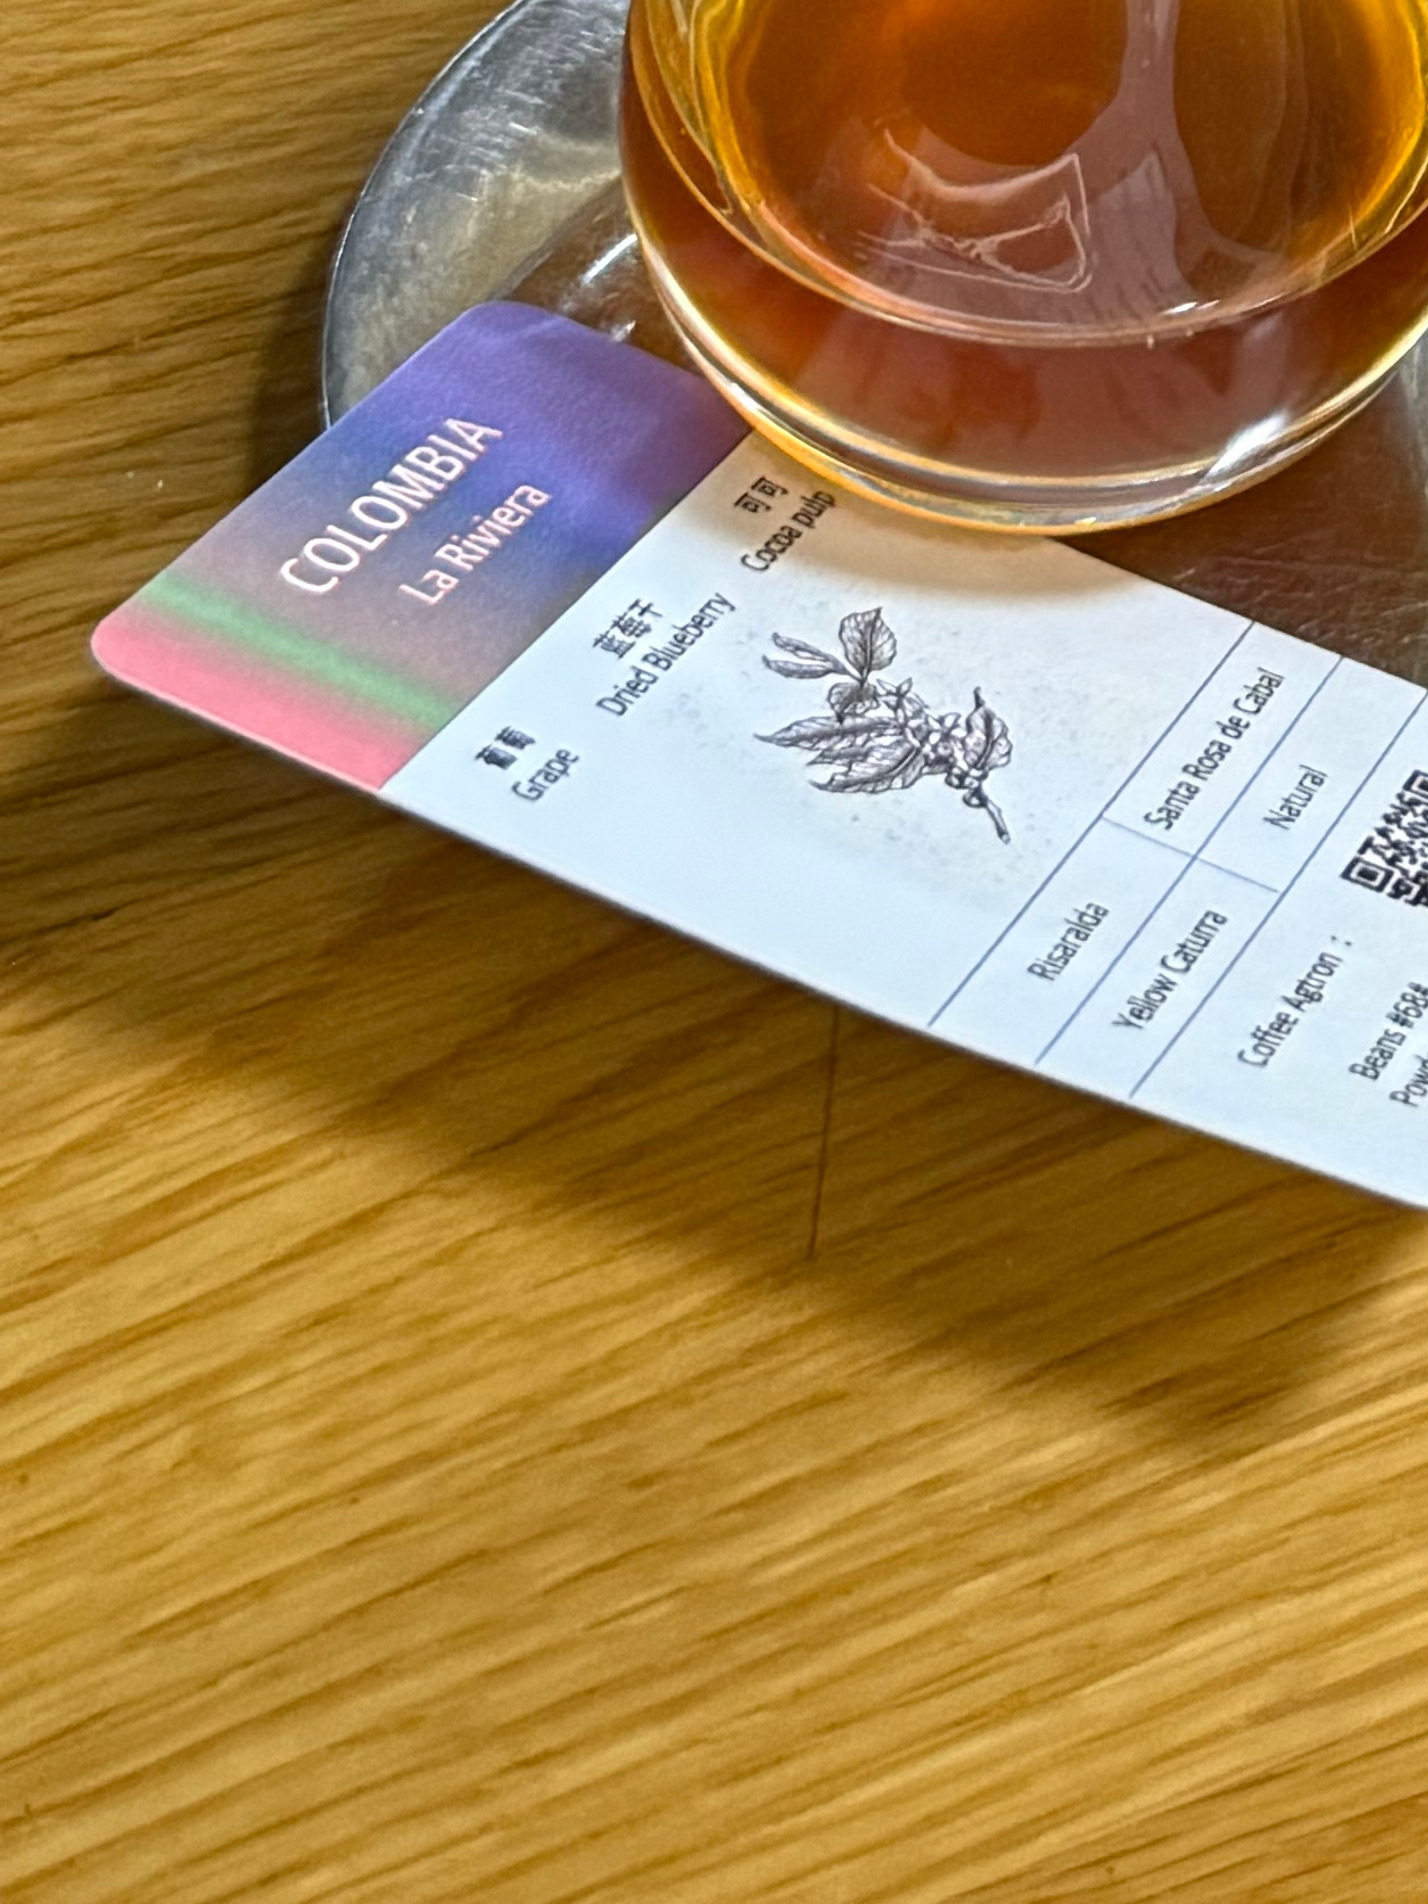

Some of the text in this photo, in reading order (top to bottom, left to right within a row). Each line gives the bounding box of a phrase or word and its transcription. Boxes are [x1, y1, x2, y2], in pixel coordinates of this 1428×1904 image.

[279, 417, 504, 594] COLOMBIA
[732, 475, 789, 514] 可可
[739, 489, 838, 573] Cocoa pulp
[398, 483, 552, 606] La Riviera
[592, 597, 664, 660] 蓝莓干
[595, 591, 737, 717] Dried Blueberry
[511, 747, 580, 803] Grape
[1142, 665, 1287, 833] Santa Rosa de Cabal
[1262, 763, 1329, 833] Natural
[1026, 900, 1110, 982] Risaralda
[1110, 907, 1229, 1032] Yellow Caturra
[1236, 1010, 1300, 1070] Coffee
[1347, 1027, 1408, 1082] Beans
